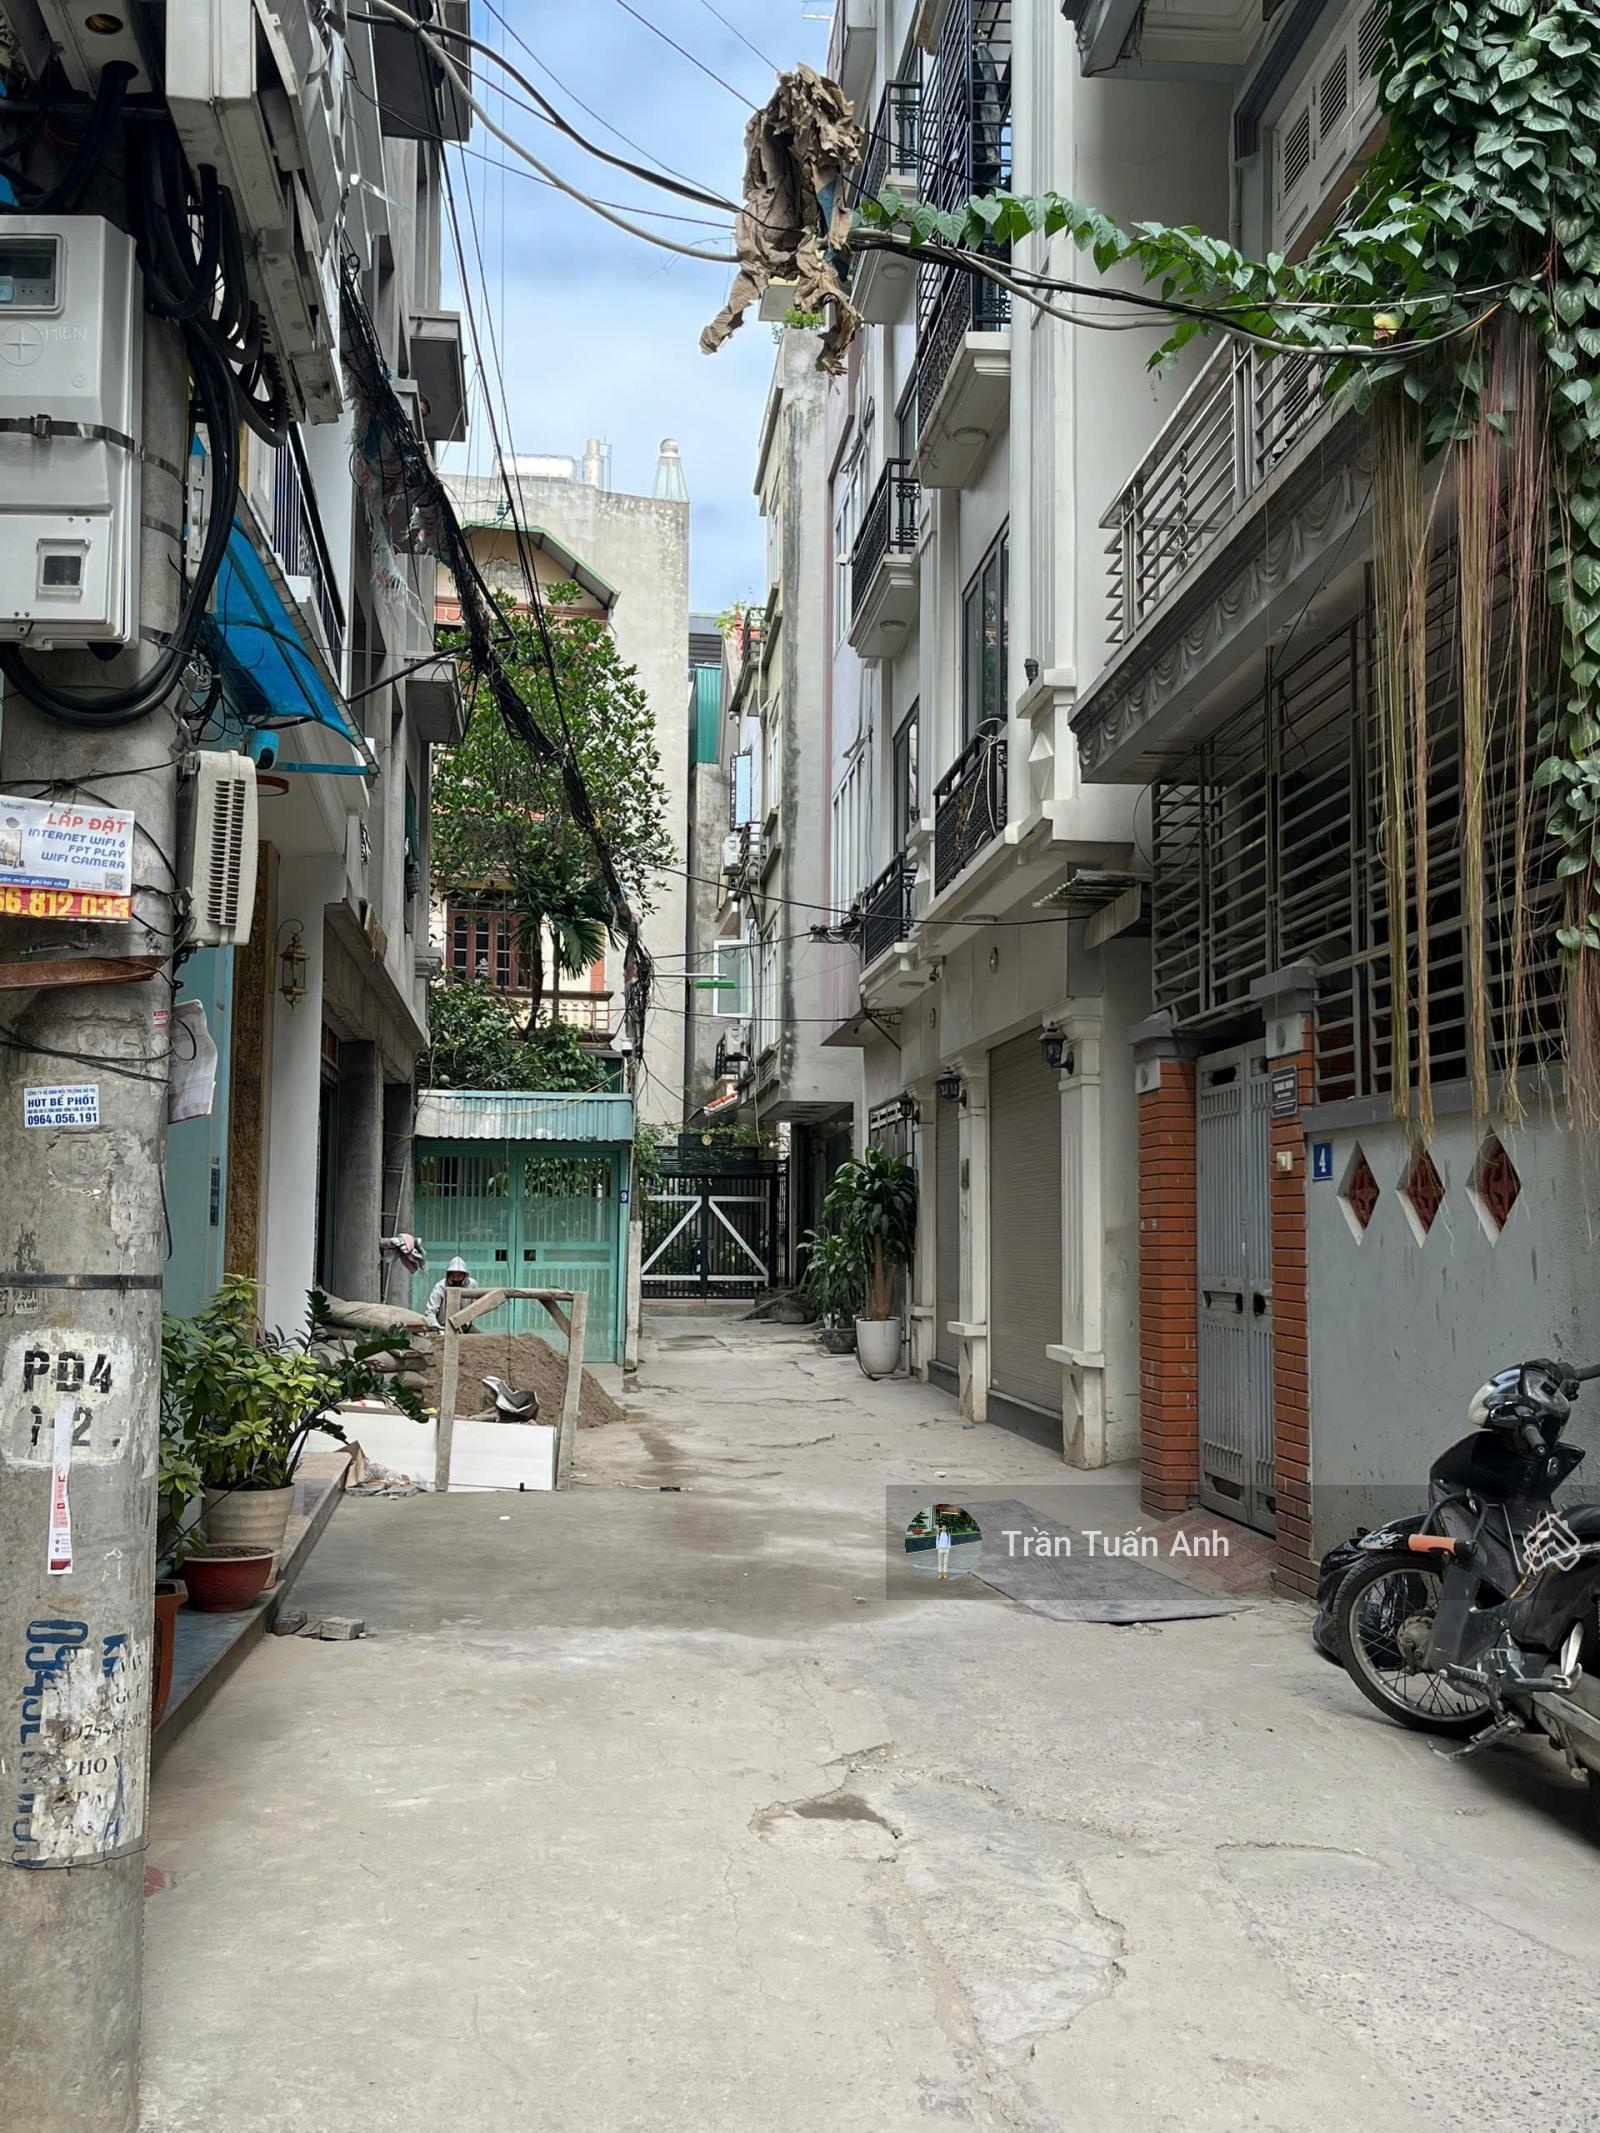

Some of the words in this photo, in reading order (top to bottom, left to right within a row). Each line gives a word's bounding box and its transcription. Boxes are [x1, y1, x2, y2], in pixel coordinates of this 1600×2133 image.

[47, 808, 84, 828] LẮP
[88, 815, 127, 835] ĐẶT
[28, 828, 87, 843] INTERNET
[89, 836, 116, 847] WIFI
[118, 839, 126, 848] 6
[68, 844, 91, 855] FPT
[93, 848, 125, 859] PLAY
[41, 852, 68, 863] WIFI
[71, 856, 125, 869] CAMERA
[27, 1112, 97, 1126] 0964.056.191
[1318, 1147, 1327, 1173] 4
[620, 1191, 628, 1202] 9
